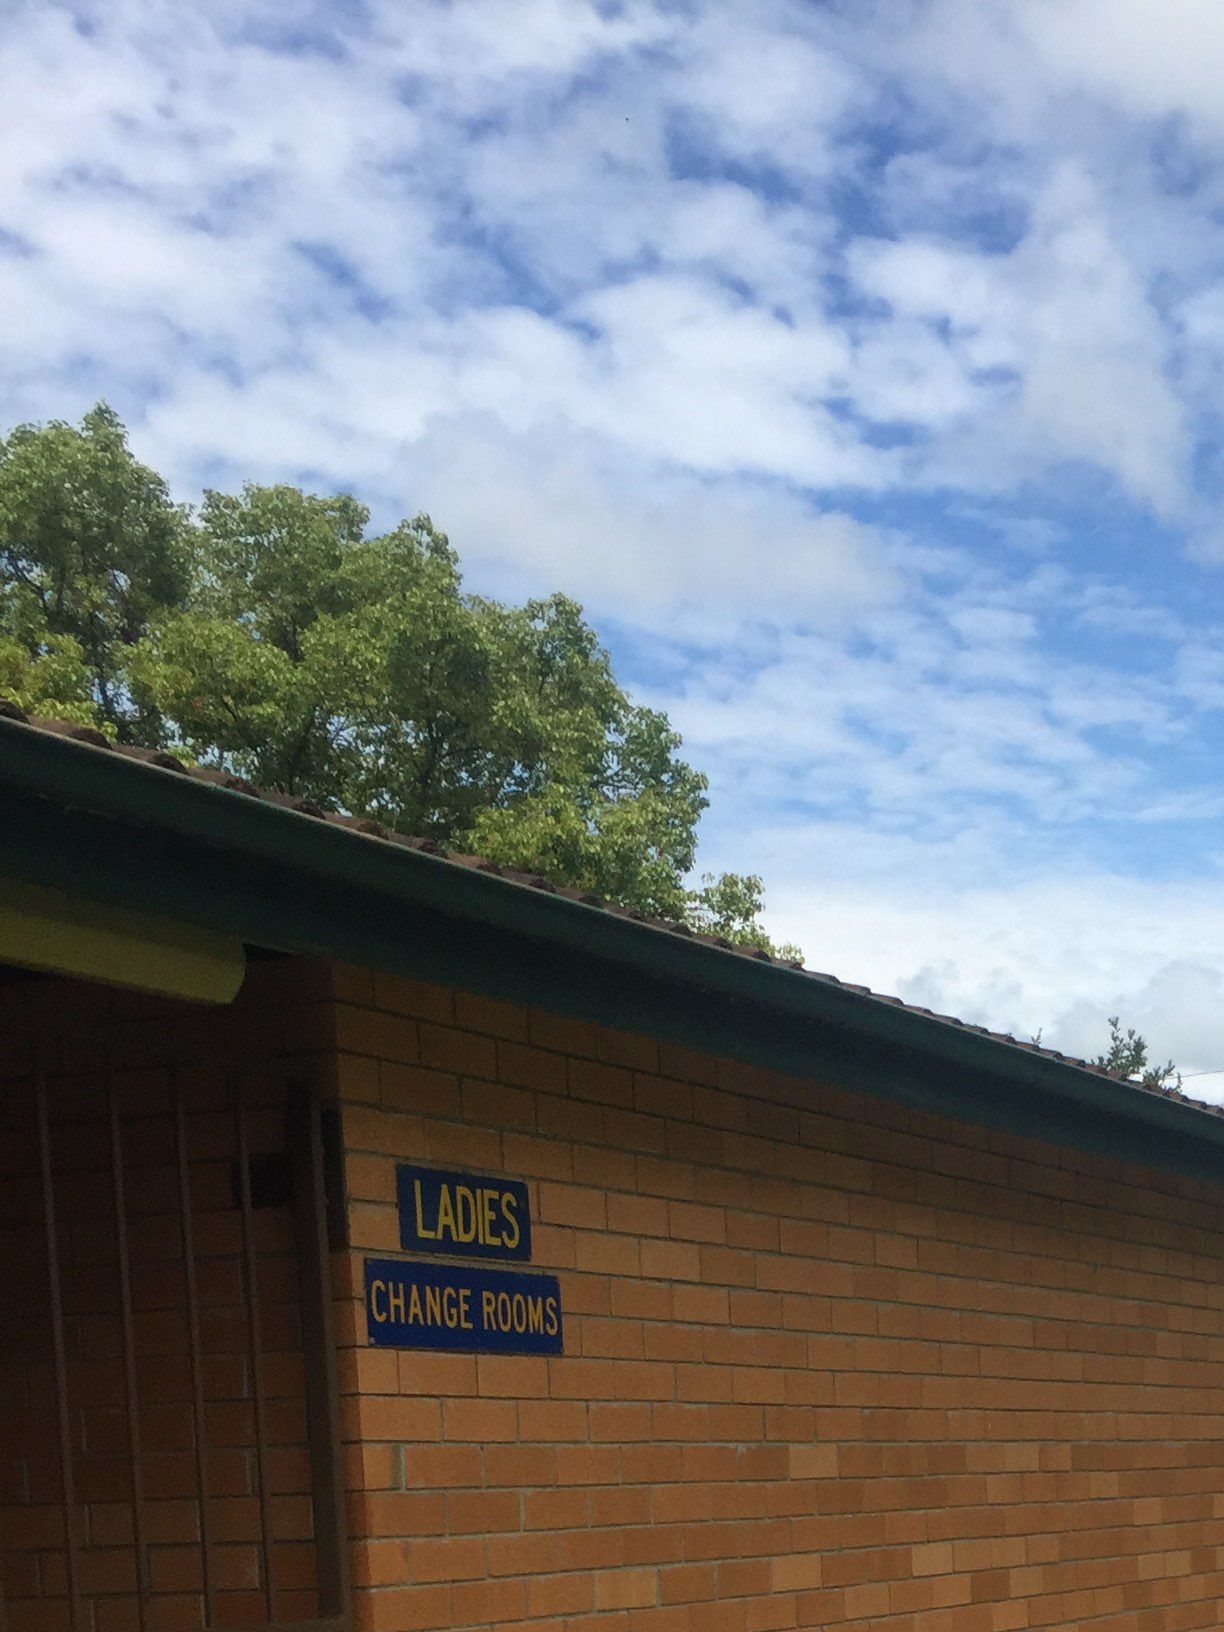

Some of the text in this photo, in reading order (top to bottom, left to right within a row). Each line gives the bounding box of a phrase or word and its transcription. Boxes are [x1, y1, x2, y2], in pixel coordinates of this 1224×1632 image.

[413, 1180, 520, 1249] LADIES
[371, 1279, 559, 1337] CHANGE ROOMS
